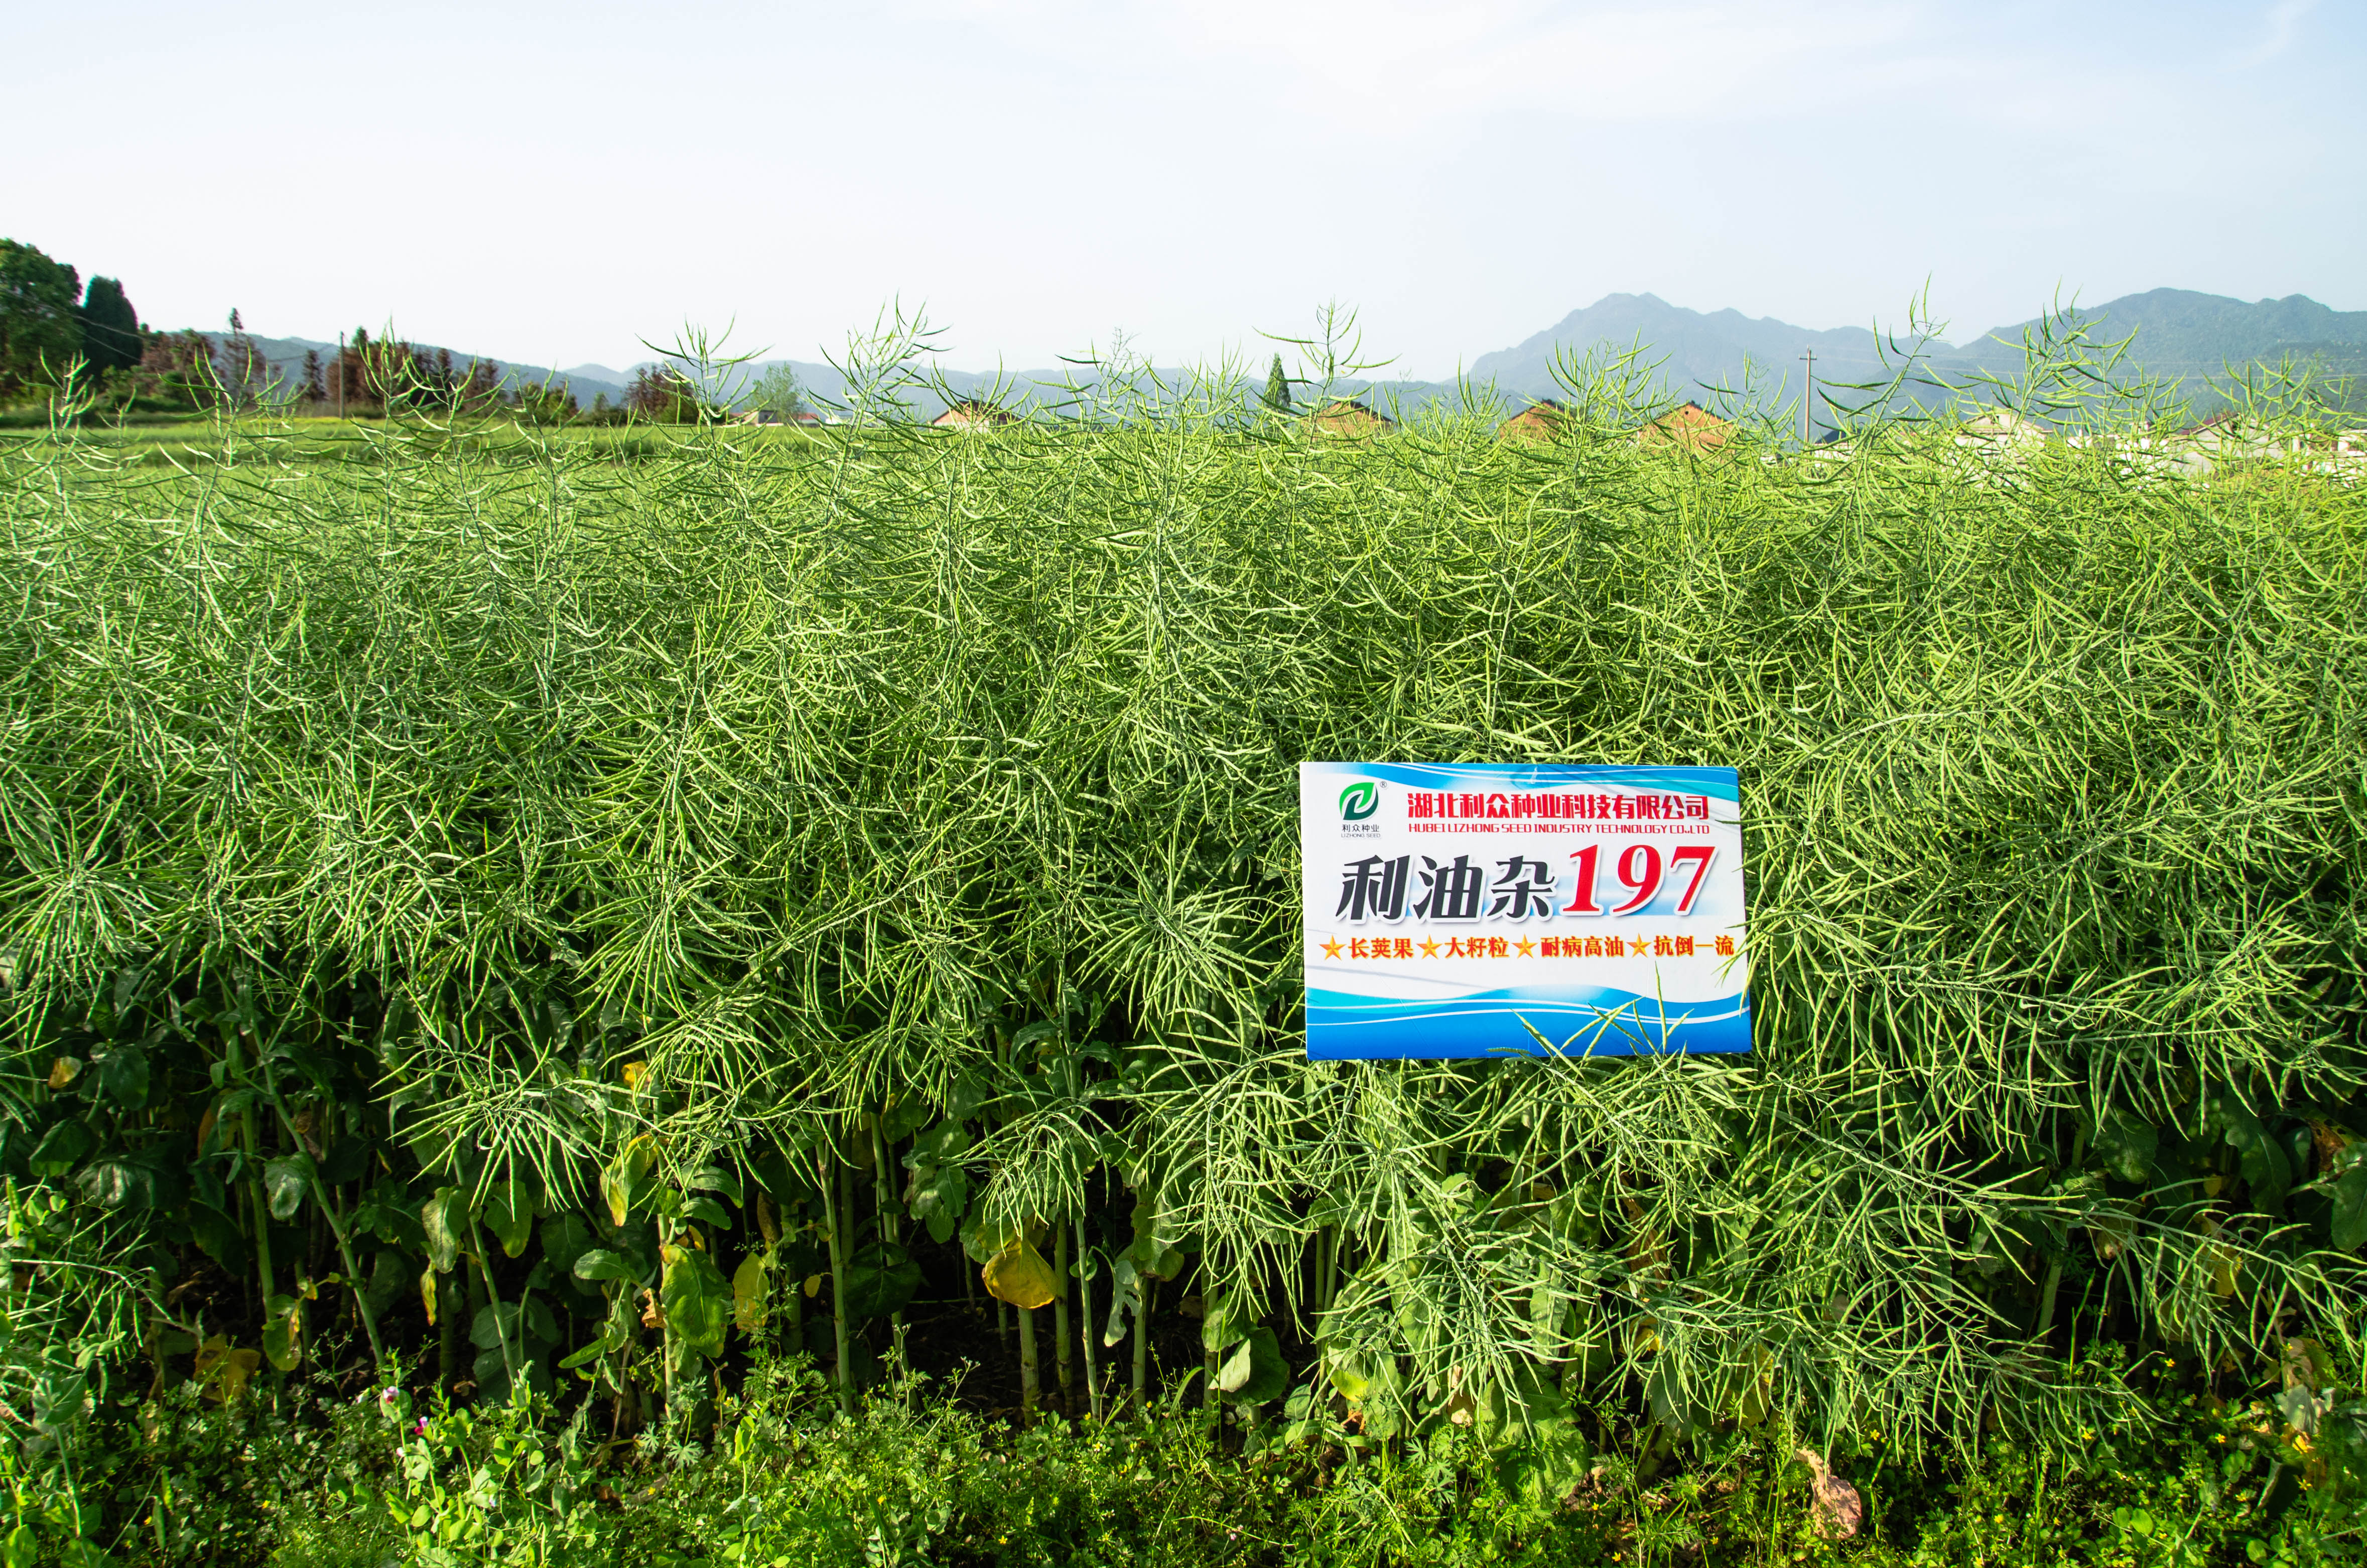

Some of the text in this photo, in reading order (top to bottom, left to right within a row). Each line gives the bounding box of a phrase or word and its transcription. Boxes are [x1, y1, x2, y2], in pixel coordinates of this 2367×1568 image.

[1408, 793, 1709, 820] 湖北利众种业科技有限公司
[1342, 824, 1380, 833] 利众种业
[1409, 824, 1445, 832] HUBEI
[1448, 824, 1499, 833] LIZHONG
[1501, 824, 1531, 833] SEED
[1534, 824, 1592, 833] INDUSTRY
[1595, 824, 1667, 834] TECHNOLOGY
[1348, 935, 1735, 960] 长荚果 大籽粒 耐病高油 抗倒一流
